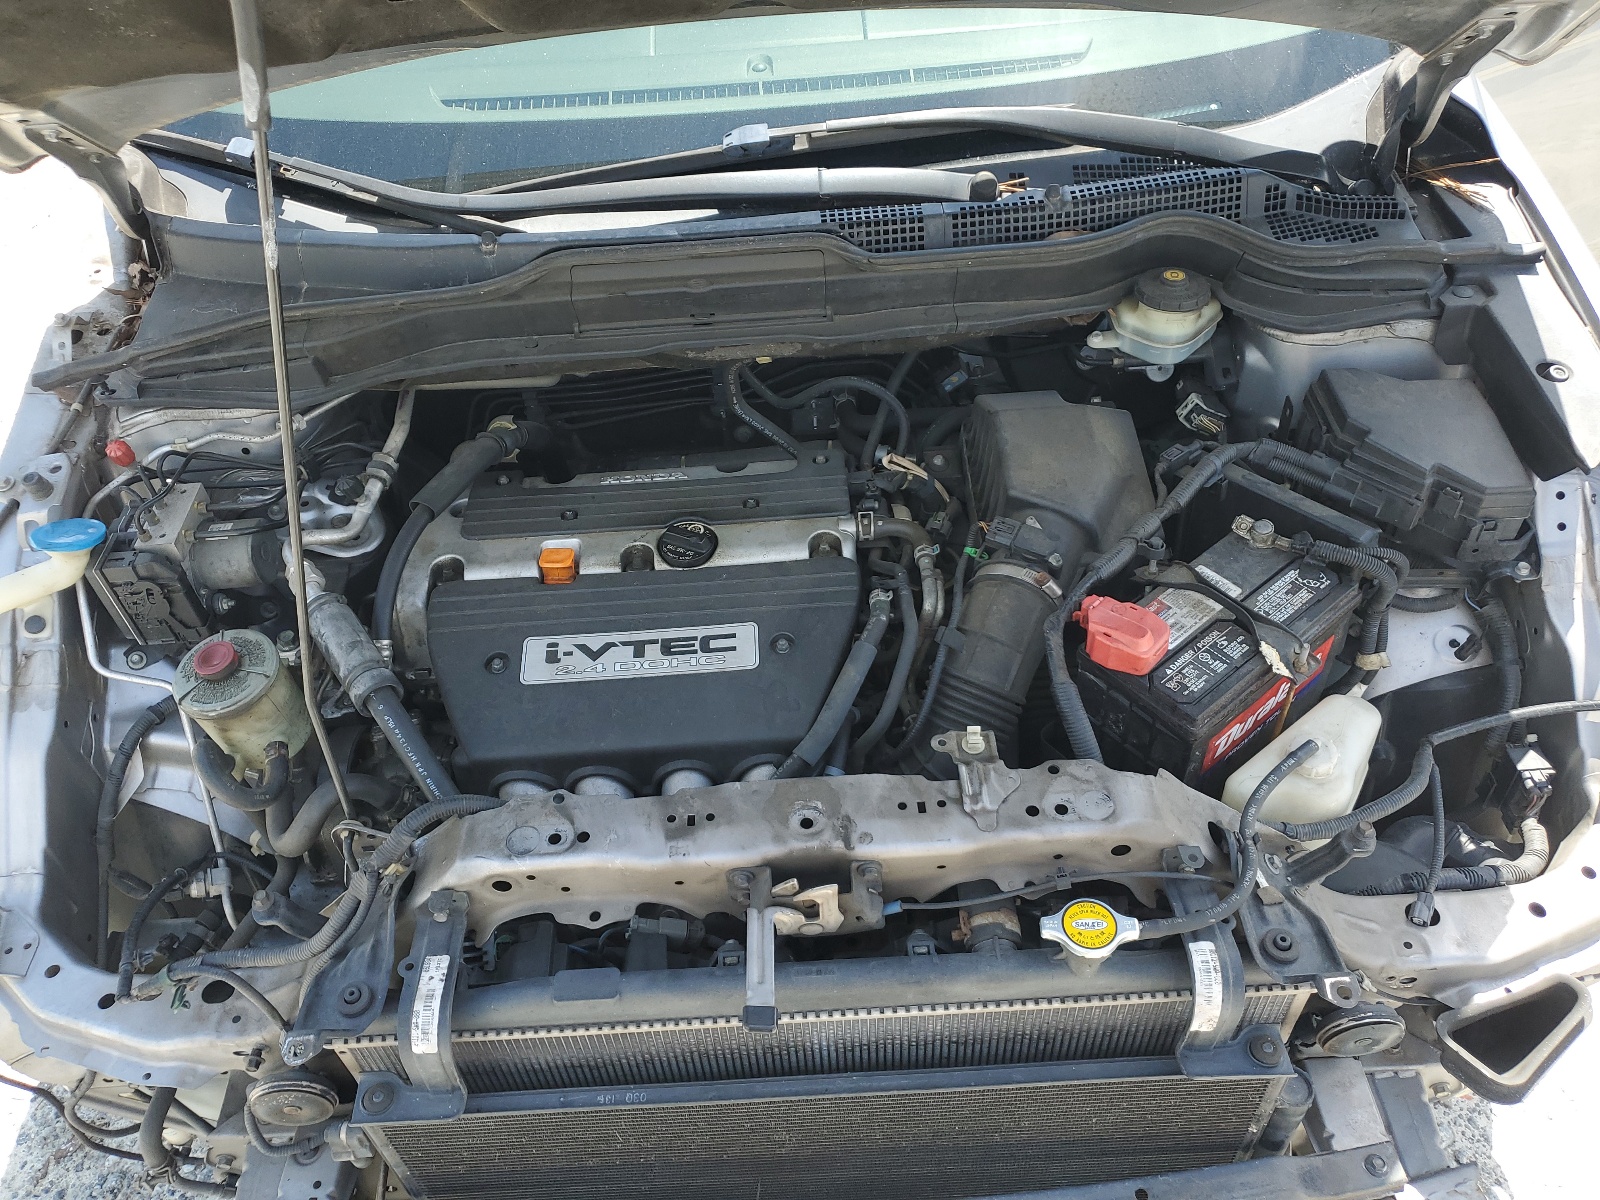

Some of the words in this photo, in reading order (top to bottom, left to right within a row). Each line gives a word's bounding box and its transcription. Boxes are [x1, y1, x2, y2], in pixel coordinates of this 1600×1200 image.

[600, 472, 688, 485] HONDA
[545, 632, 737, 664] i-VTEC
[1172, 649, 1196, 670] DANGER
[1197, 629, 1221, 649] POISON
[555, 663, 606, 675] 2.4
[613, 655, 726, 672] DOHC
